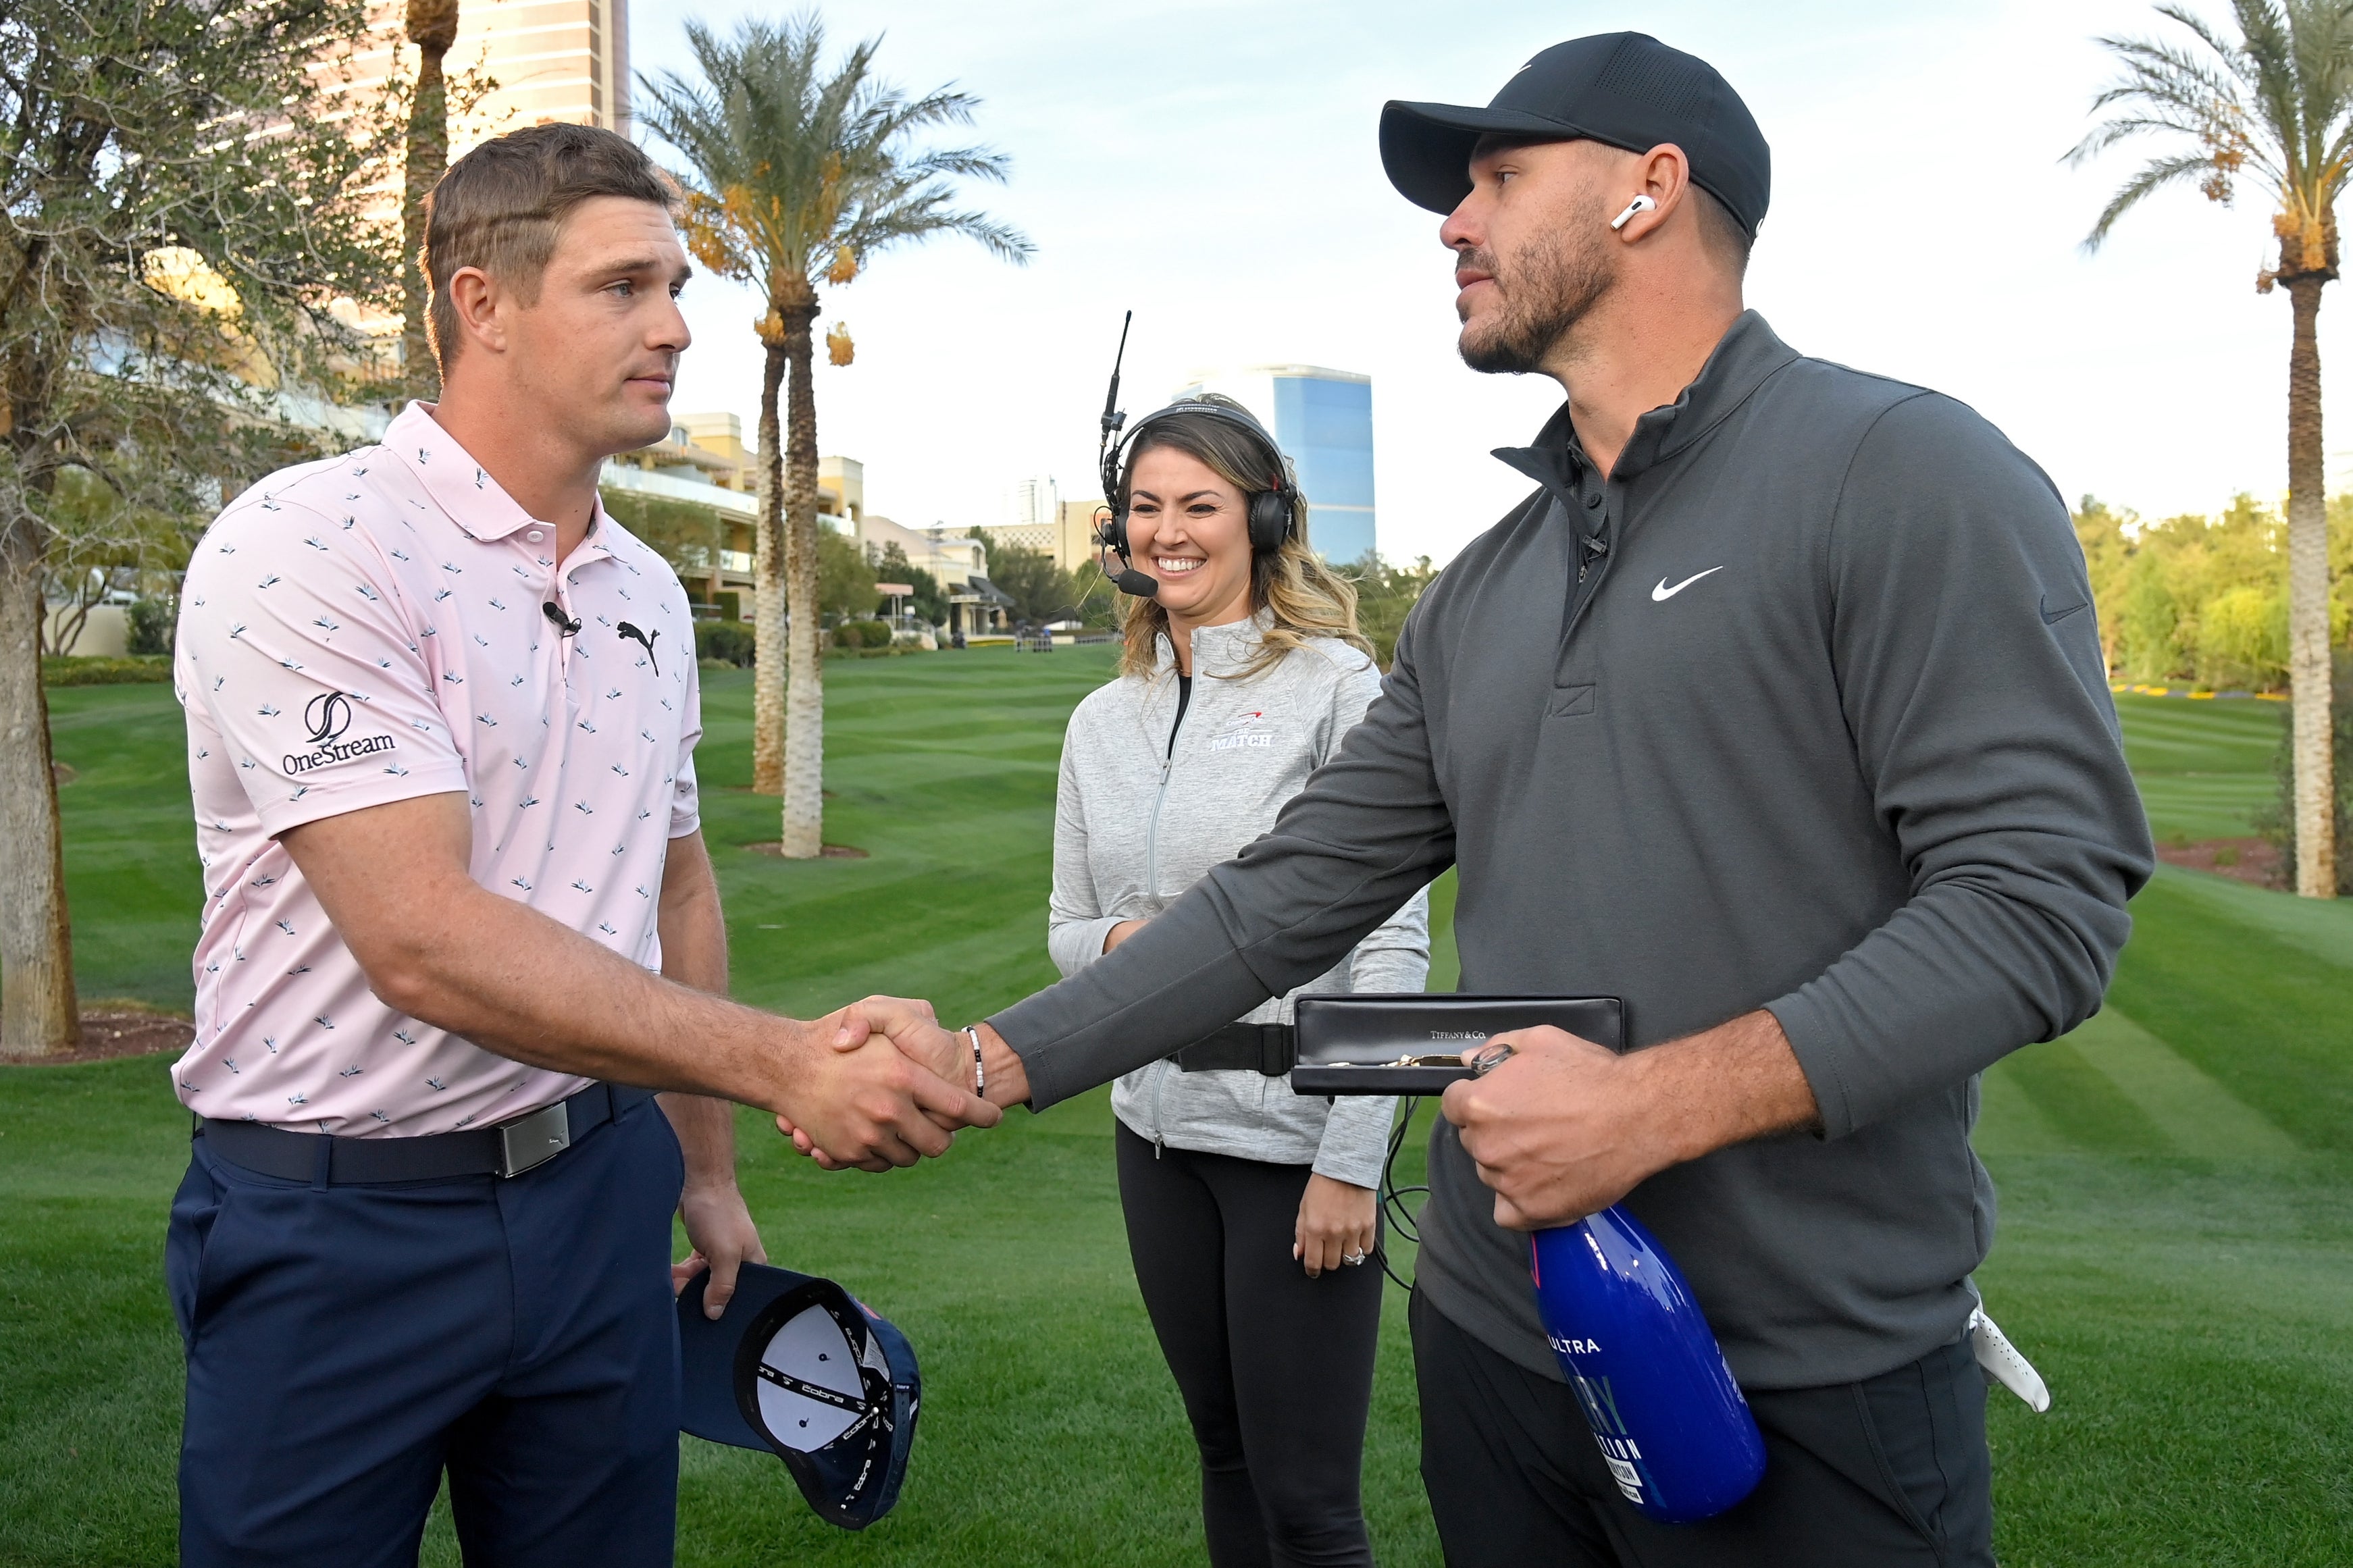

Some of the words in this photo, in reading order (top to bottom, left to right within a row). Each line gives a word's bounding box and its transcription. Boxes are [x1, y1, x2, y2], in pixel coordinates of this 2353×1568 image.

[1210, 734, 1272, 752] MATCH
[282, 734, 396, 775] OneStream
[1547, 1334, 1601, 1354] ULTRA
